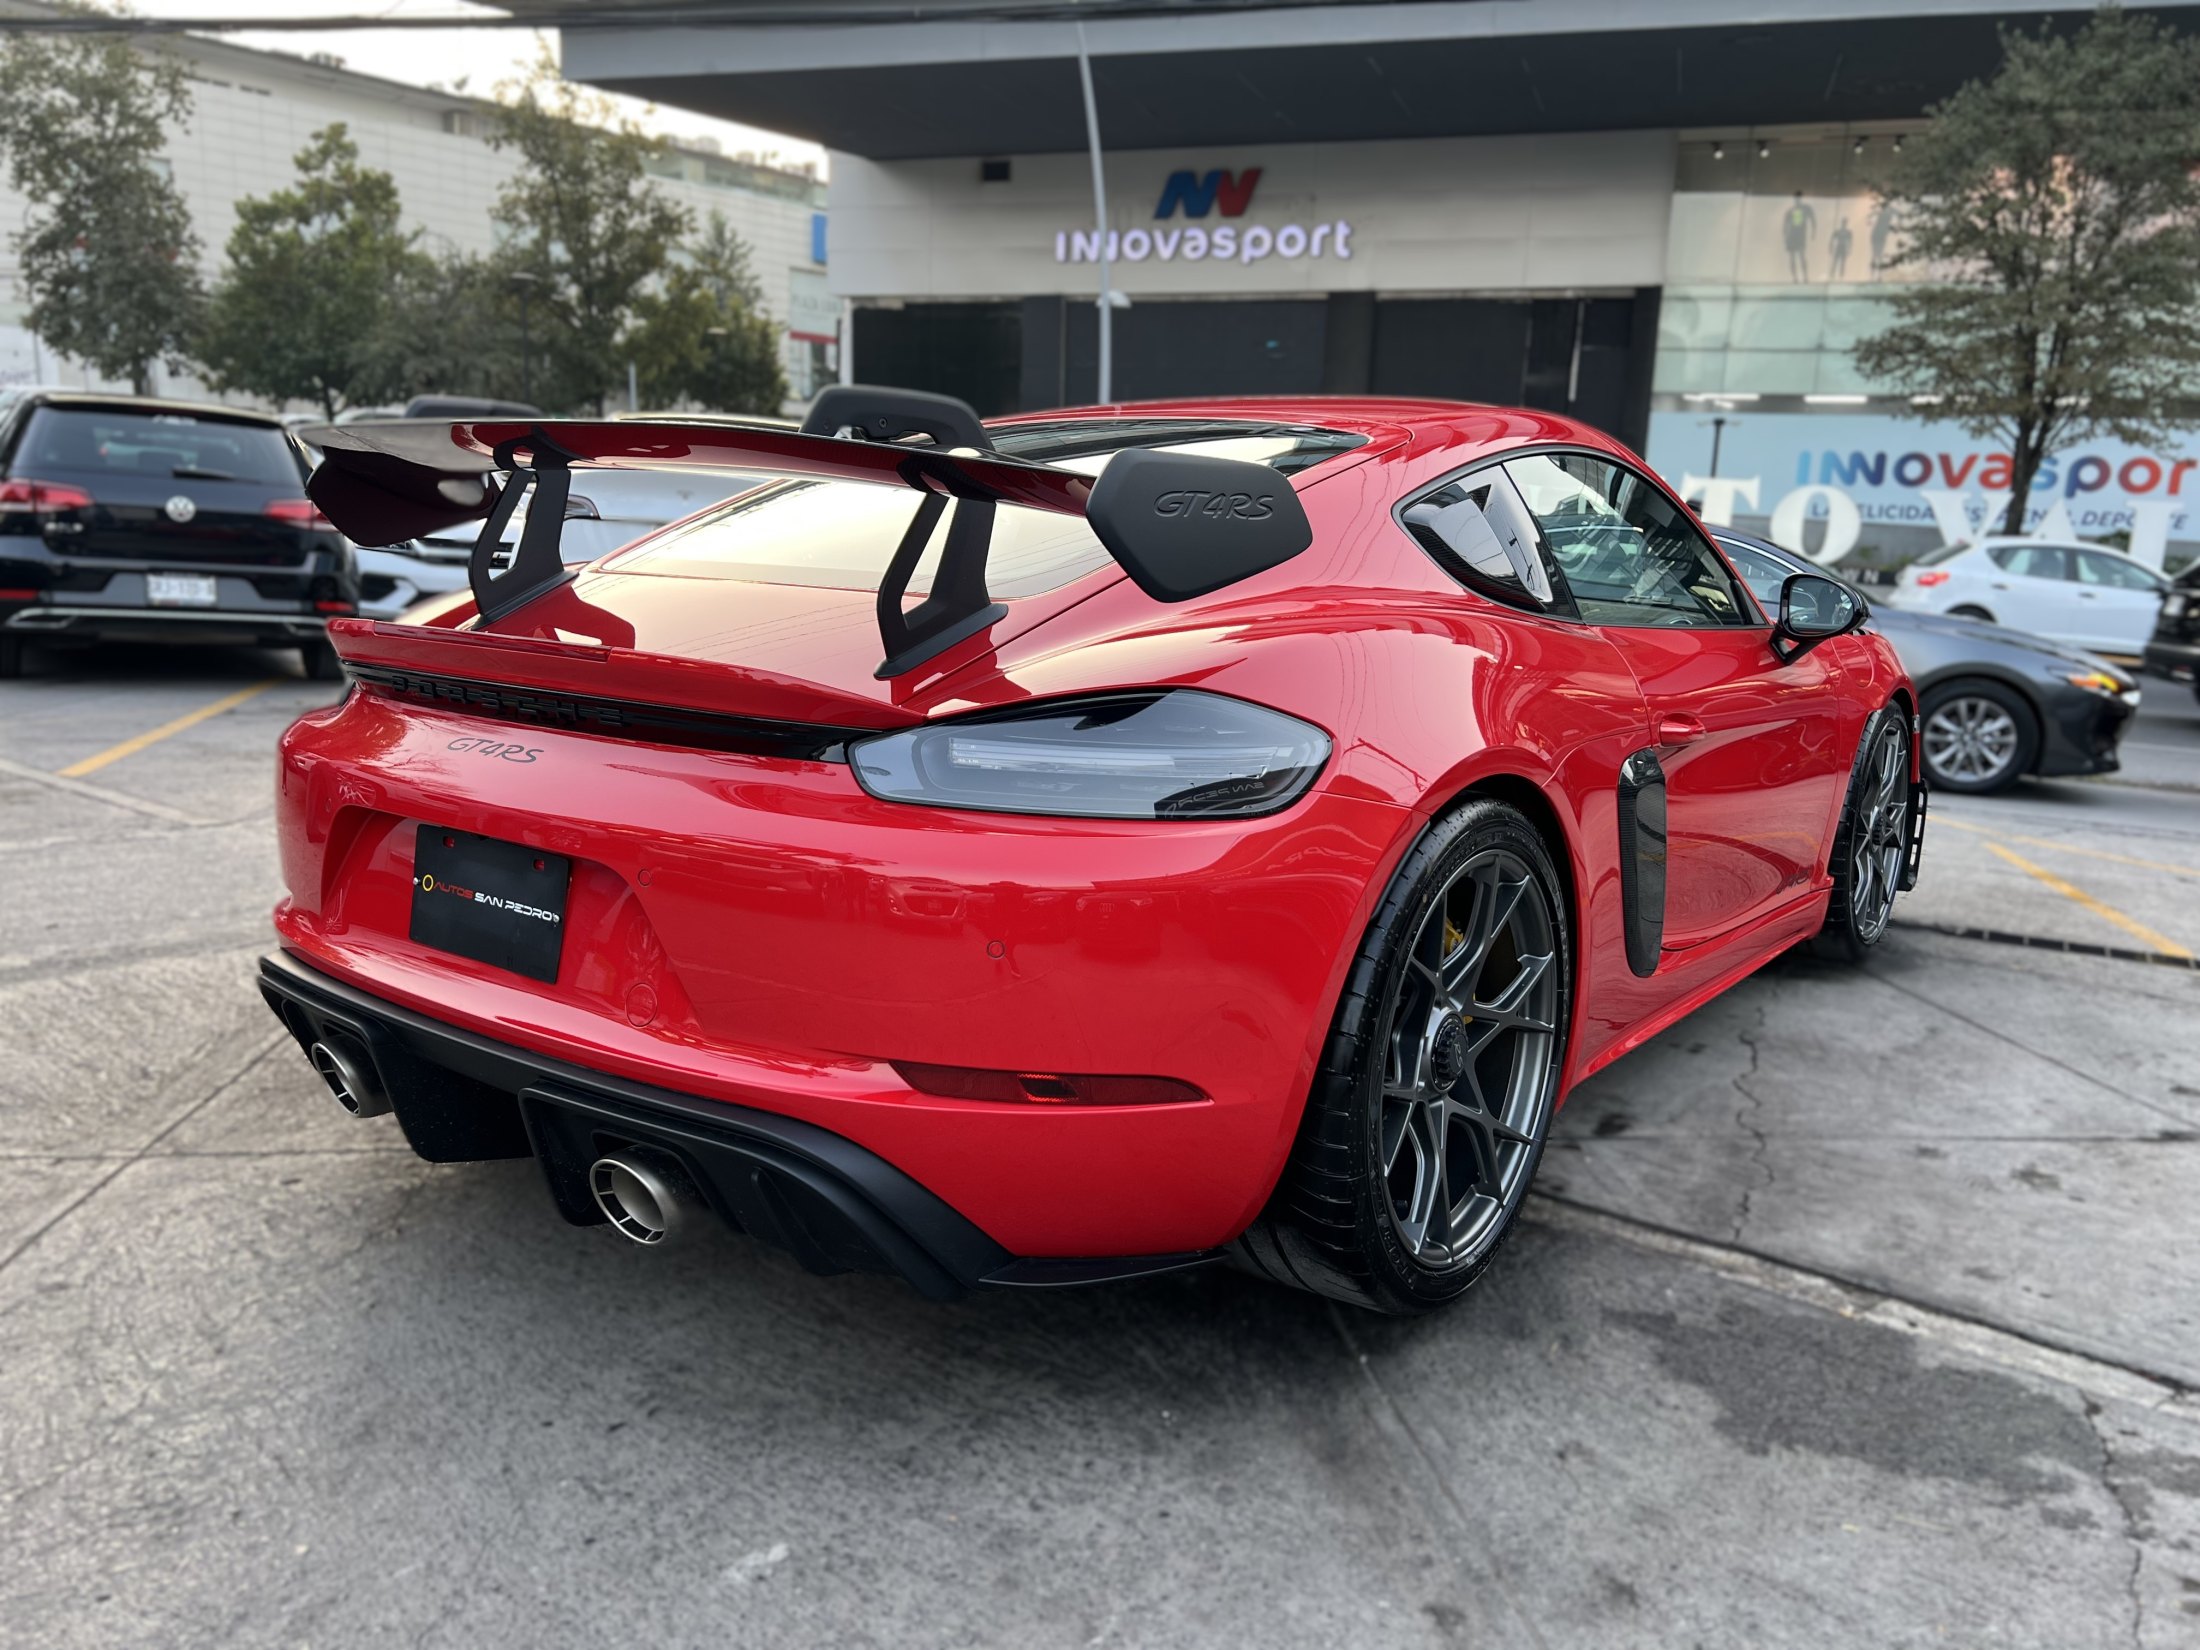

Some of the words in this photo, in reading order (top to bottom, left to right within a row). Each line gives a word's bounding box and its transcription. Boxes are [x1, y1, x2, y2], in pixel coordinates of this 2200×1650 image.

[1154, 490, 1274, 520] GT4RS
[447, 737, 545, 763] GT4RS
[434, 881, 474, 899] AUTOS
[474, 891, 503, 908] SAN
[504, 900, 553, 921] PEDRO
